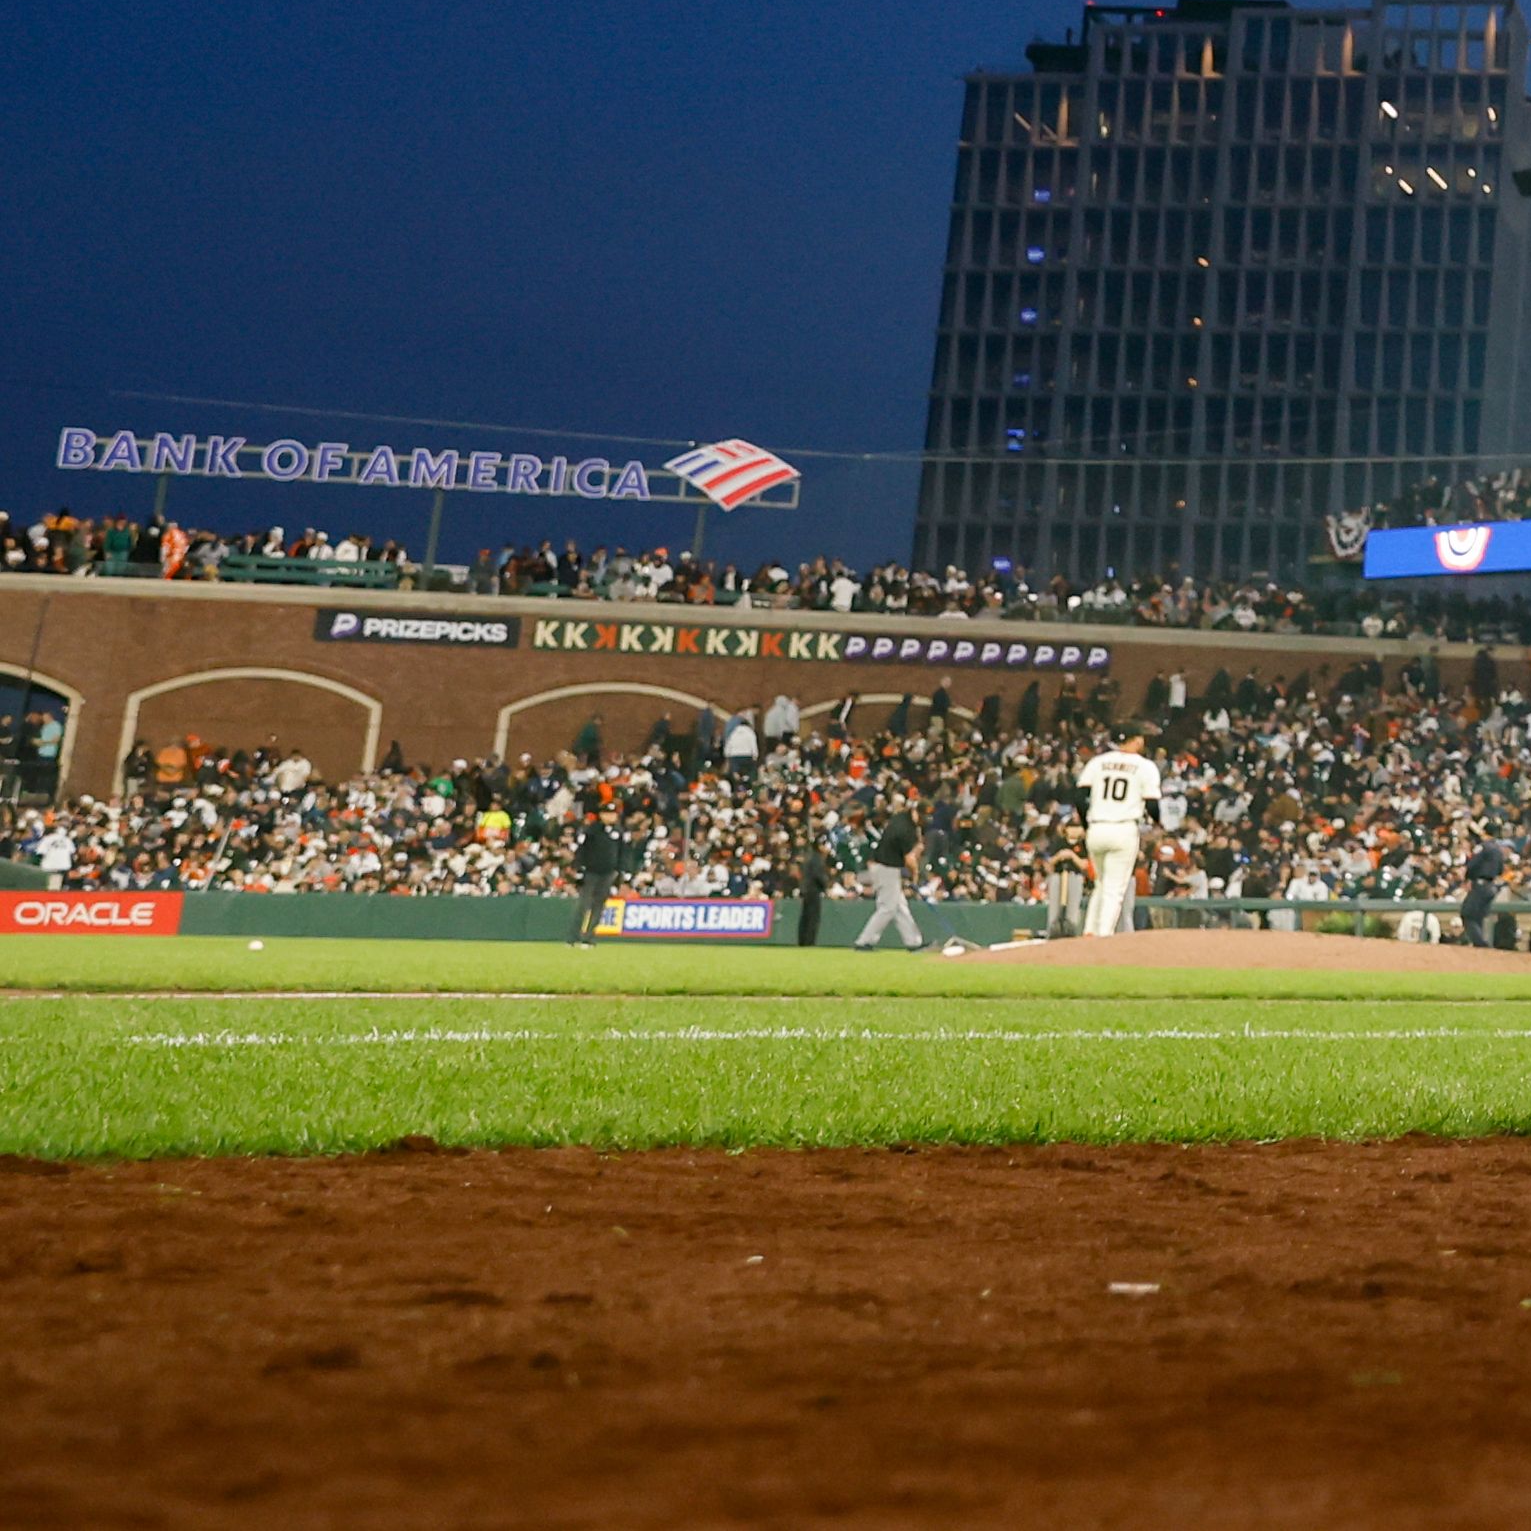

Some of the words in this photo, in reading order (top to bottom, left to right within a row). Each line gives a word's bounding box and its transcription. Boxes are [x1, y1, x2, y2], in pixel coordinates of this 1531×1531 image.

[57, 426, 247, 478] BANK
[262, 438, 350, 482] OF
[358, 444, 651, 502] AMERICA
[363, 617, 508, 643] PRIZEPICKS
[1103, 776, 1128, 801] 10
[14, 901, 156, 926] ORACLE
[624, 904, 696, 931] SPORTS
[696, 905, 766, 931] LEADER
